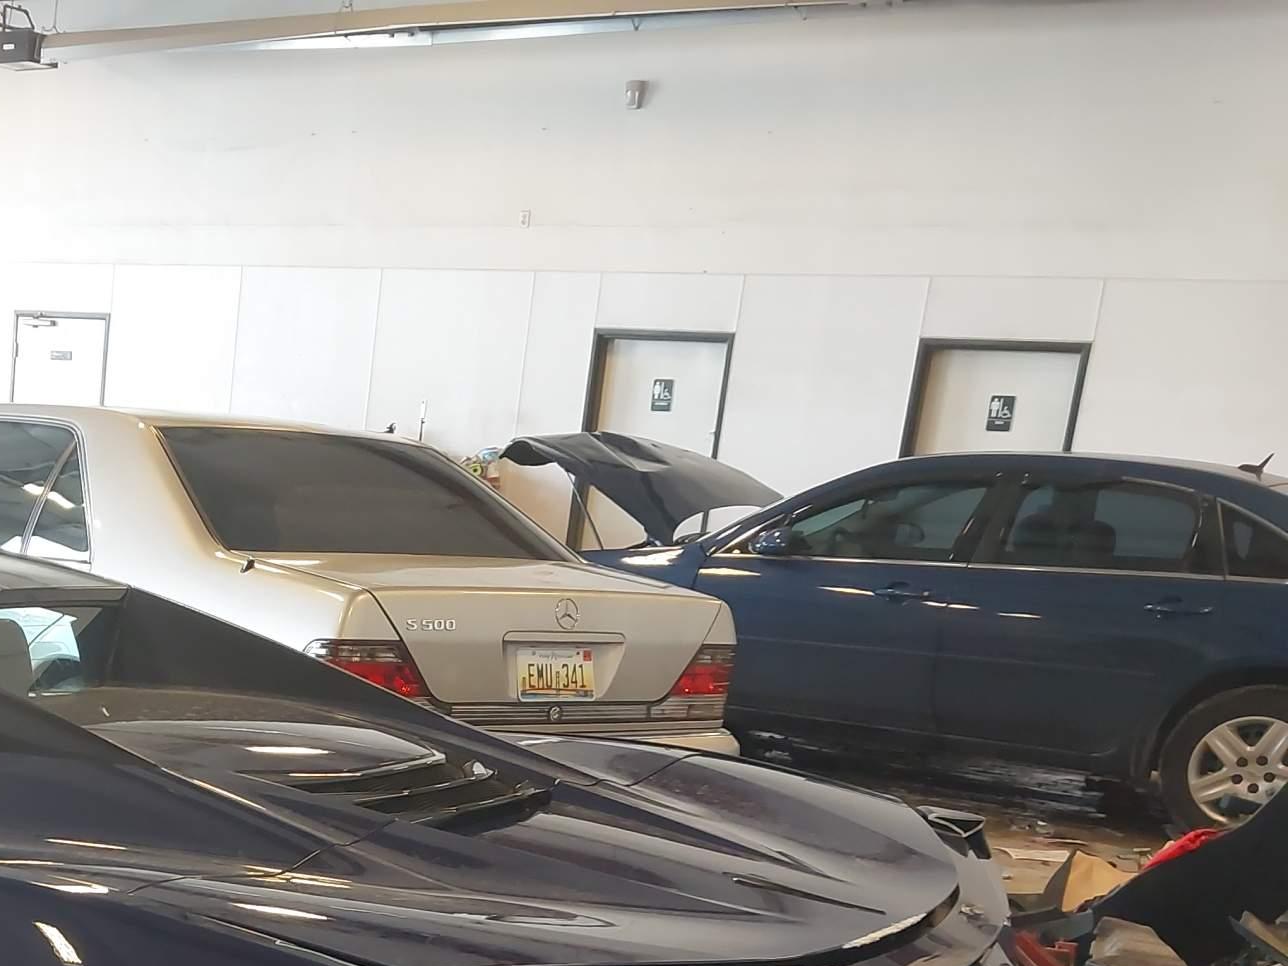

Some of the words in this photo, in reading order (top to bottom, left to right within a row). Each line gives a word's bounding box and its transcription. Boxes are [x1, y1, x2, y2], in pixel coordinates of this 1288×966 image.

[407, 619, 417, 630] S
[422, 619, 456, 631] 500
[528, 664, 553, 689] EMU
[561, 664, 586, 688] 341
